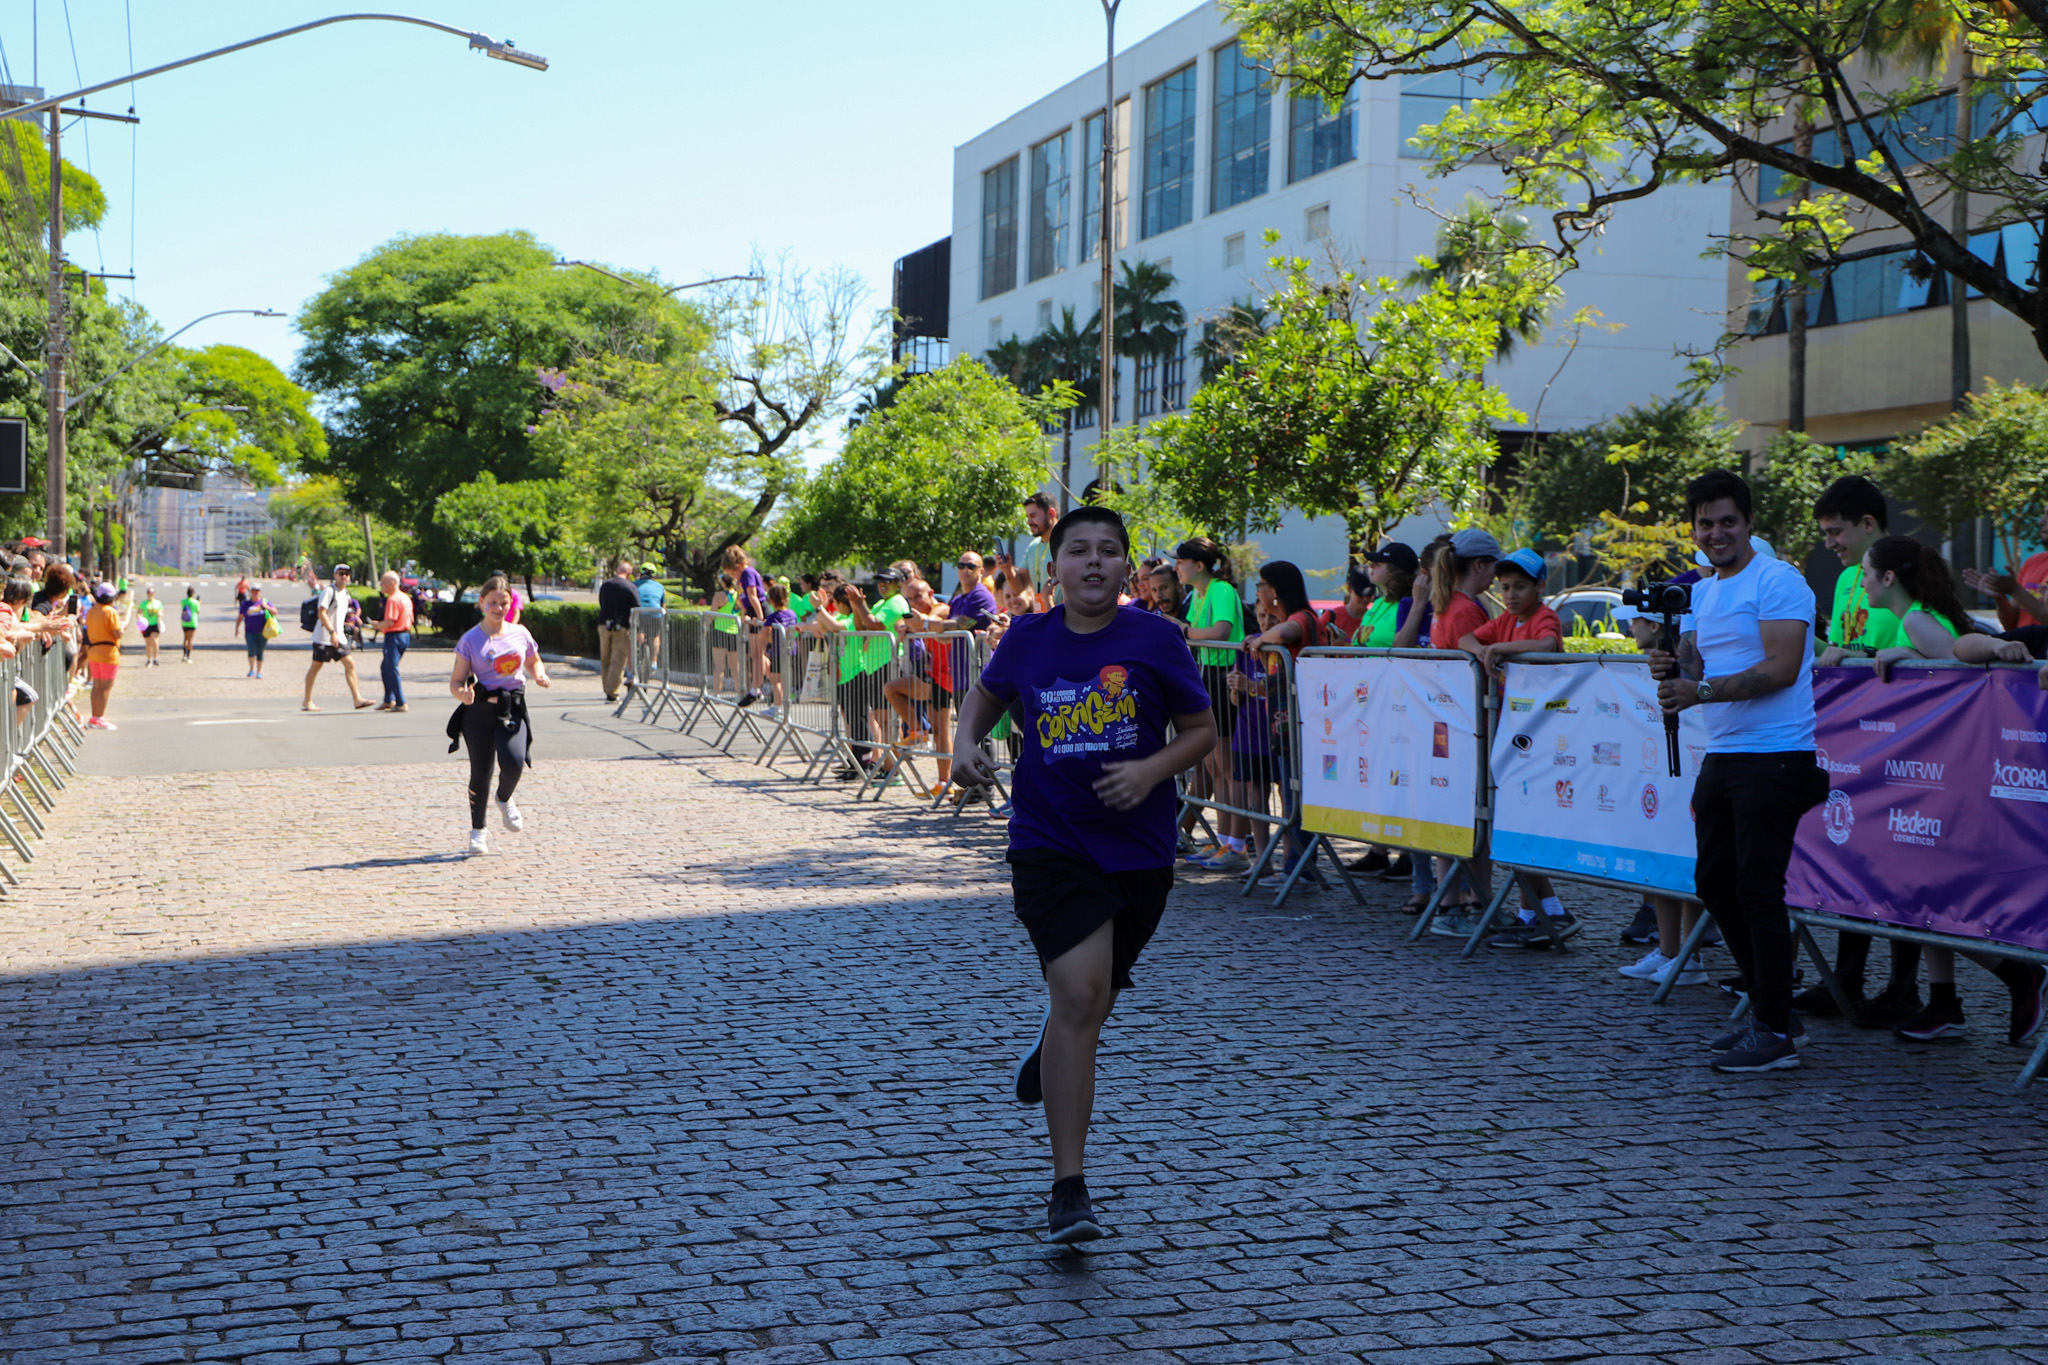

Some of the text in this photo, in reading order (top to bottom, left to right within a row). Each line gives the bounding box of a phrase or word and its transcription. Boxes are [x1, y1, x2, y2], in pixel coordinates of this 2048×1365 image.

[1062, 743, 1074, 754] que
[1074, 742, 1085, 752] nos
[1553, 756, 1577, 767] UNINTER
[2001, 765, 2047, 789] CORPA
[1888, 807, 1943, 837] Hedera
[1893, 833, 1936, 847] COSMÉTICOS
